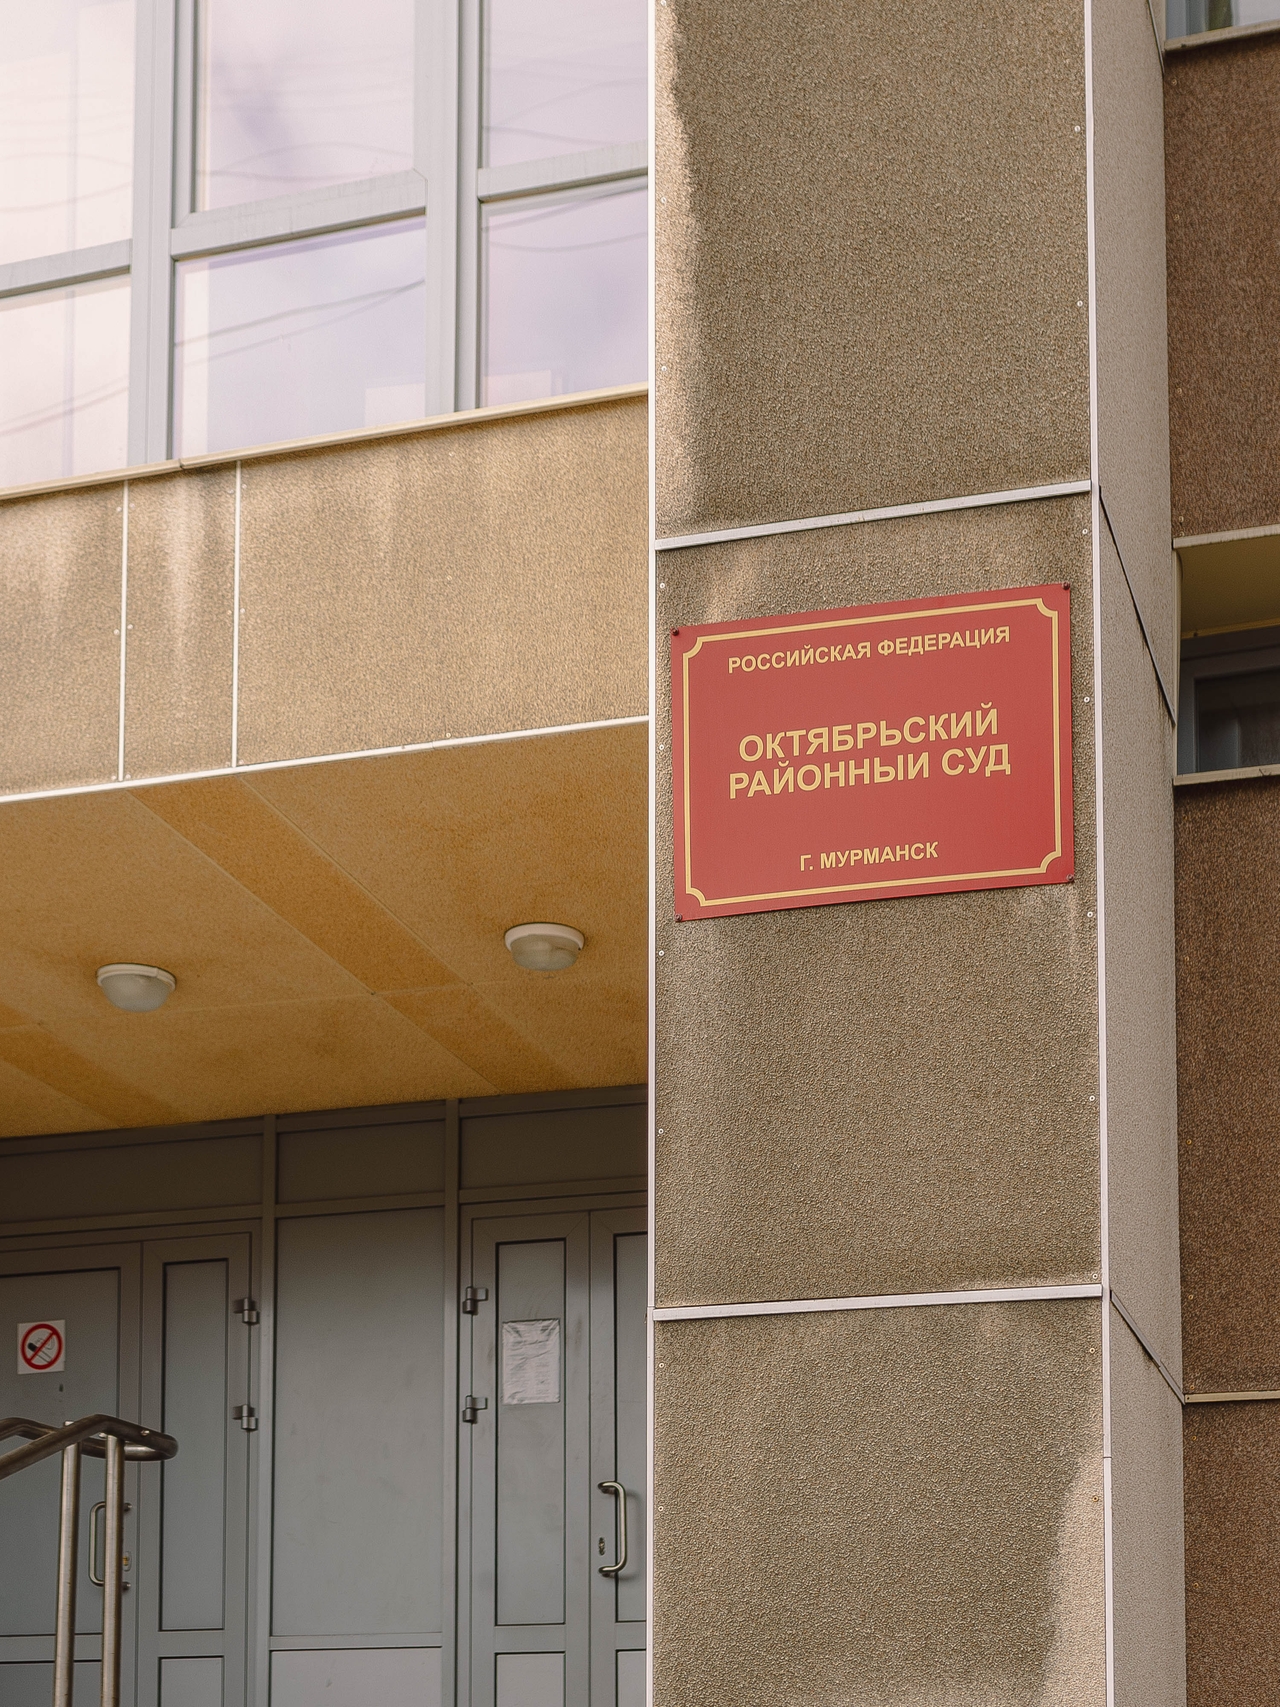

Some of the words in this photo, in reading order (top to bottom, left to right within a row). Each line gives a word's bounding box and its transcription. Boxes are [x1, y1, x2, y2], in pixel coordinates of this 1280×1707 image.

[728, 642, 871, 673] РОССИЙСКАЯ
[877, 625, 1010, 656] ФЕДЕРАЦИЯ
[738, 701, 999, 762] ОКТЯБРЬСКИЙ
[941, 743, 1011, 777] СУД
[800, 855, 814, 872] Г.
[820, 842, 938, 868] МУРМАНСК
